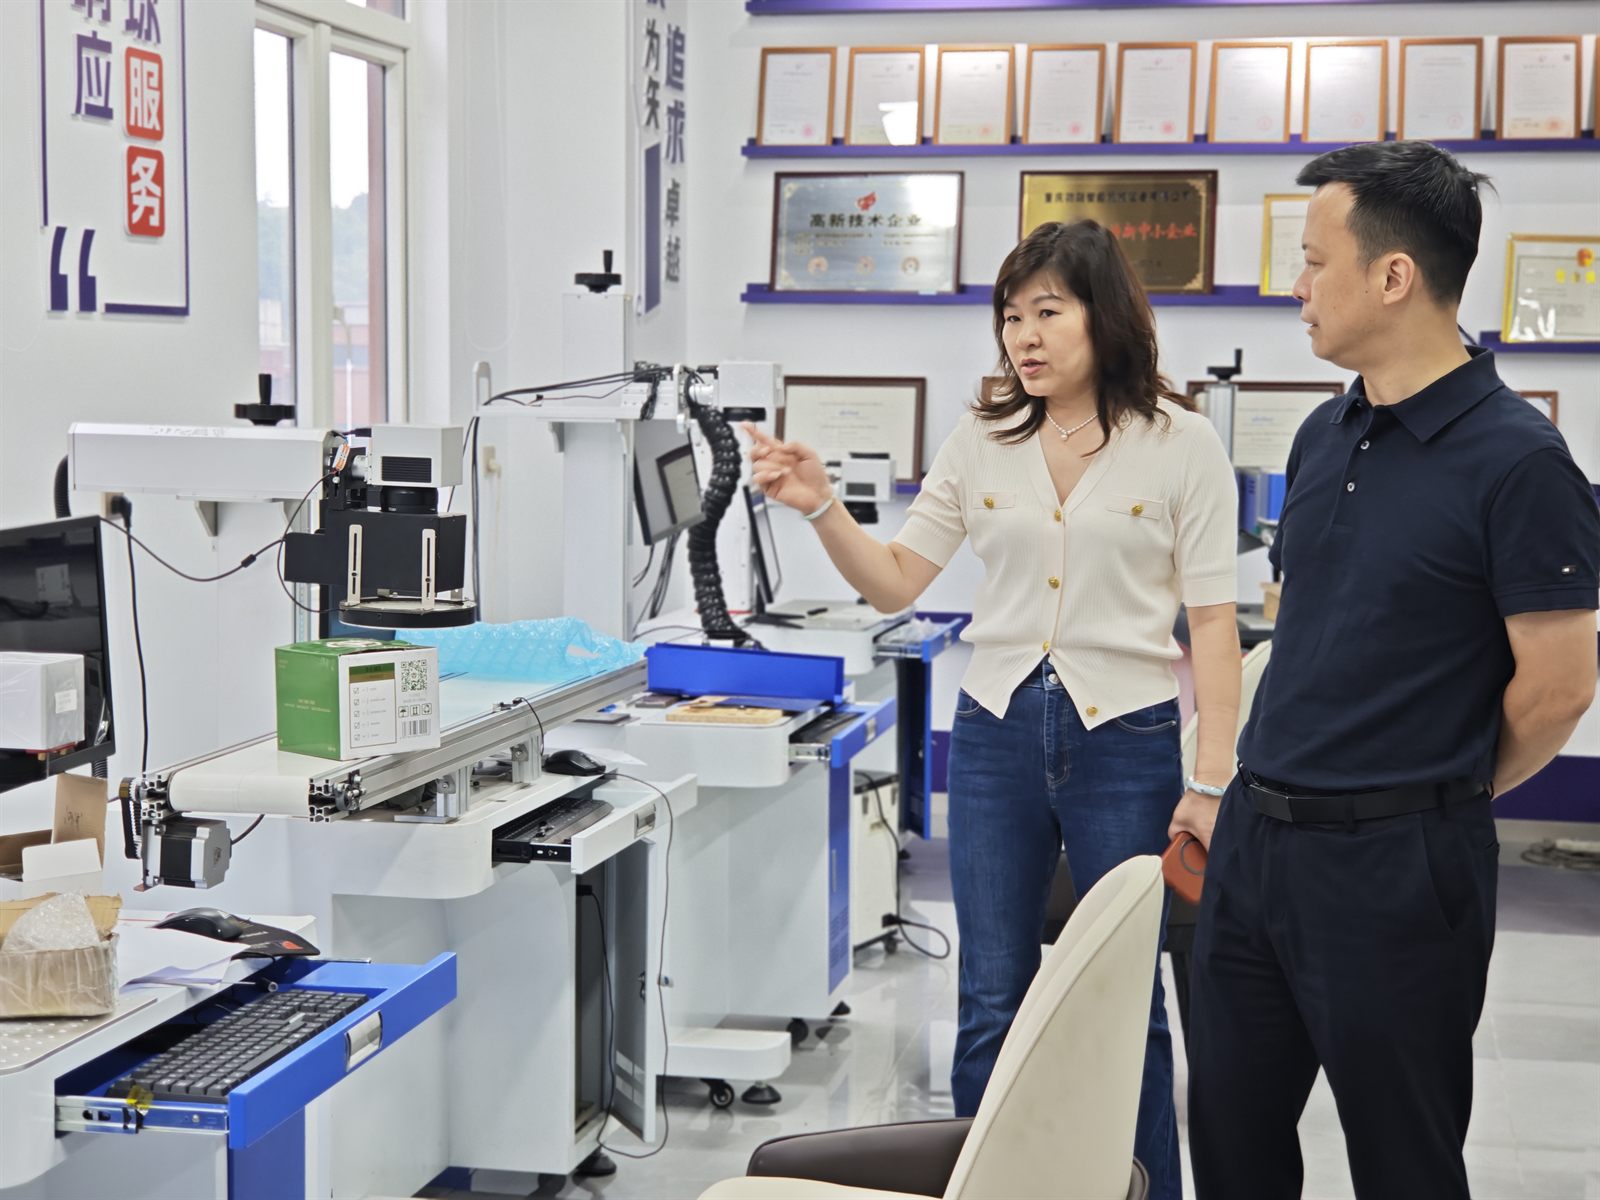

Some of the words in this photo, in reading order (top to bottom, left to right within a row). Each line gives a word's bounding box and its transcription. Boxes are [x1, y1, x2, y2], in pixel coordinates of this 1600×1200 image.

[72, 0, 114, 120] 应
[645, 0, 665, 130] 为矢
[665, 24, 686, 283] 追求卓越
[810, 213, 921, 228] 高新技术企业
